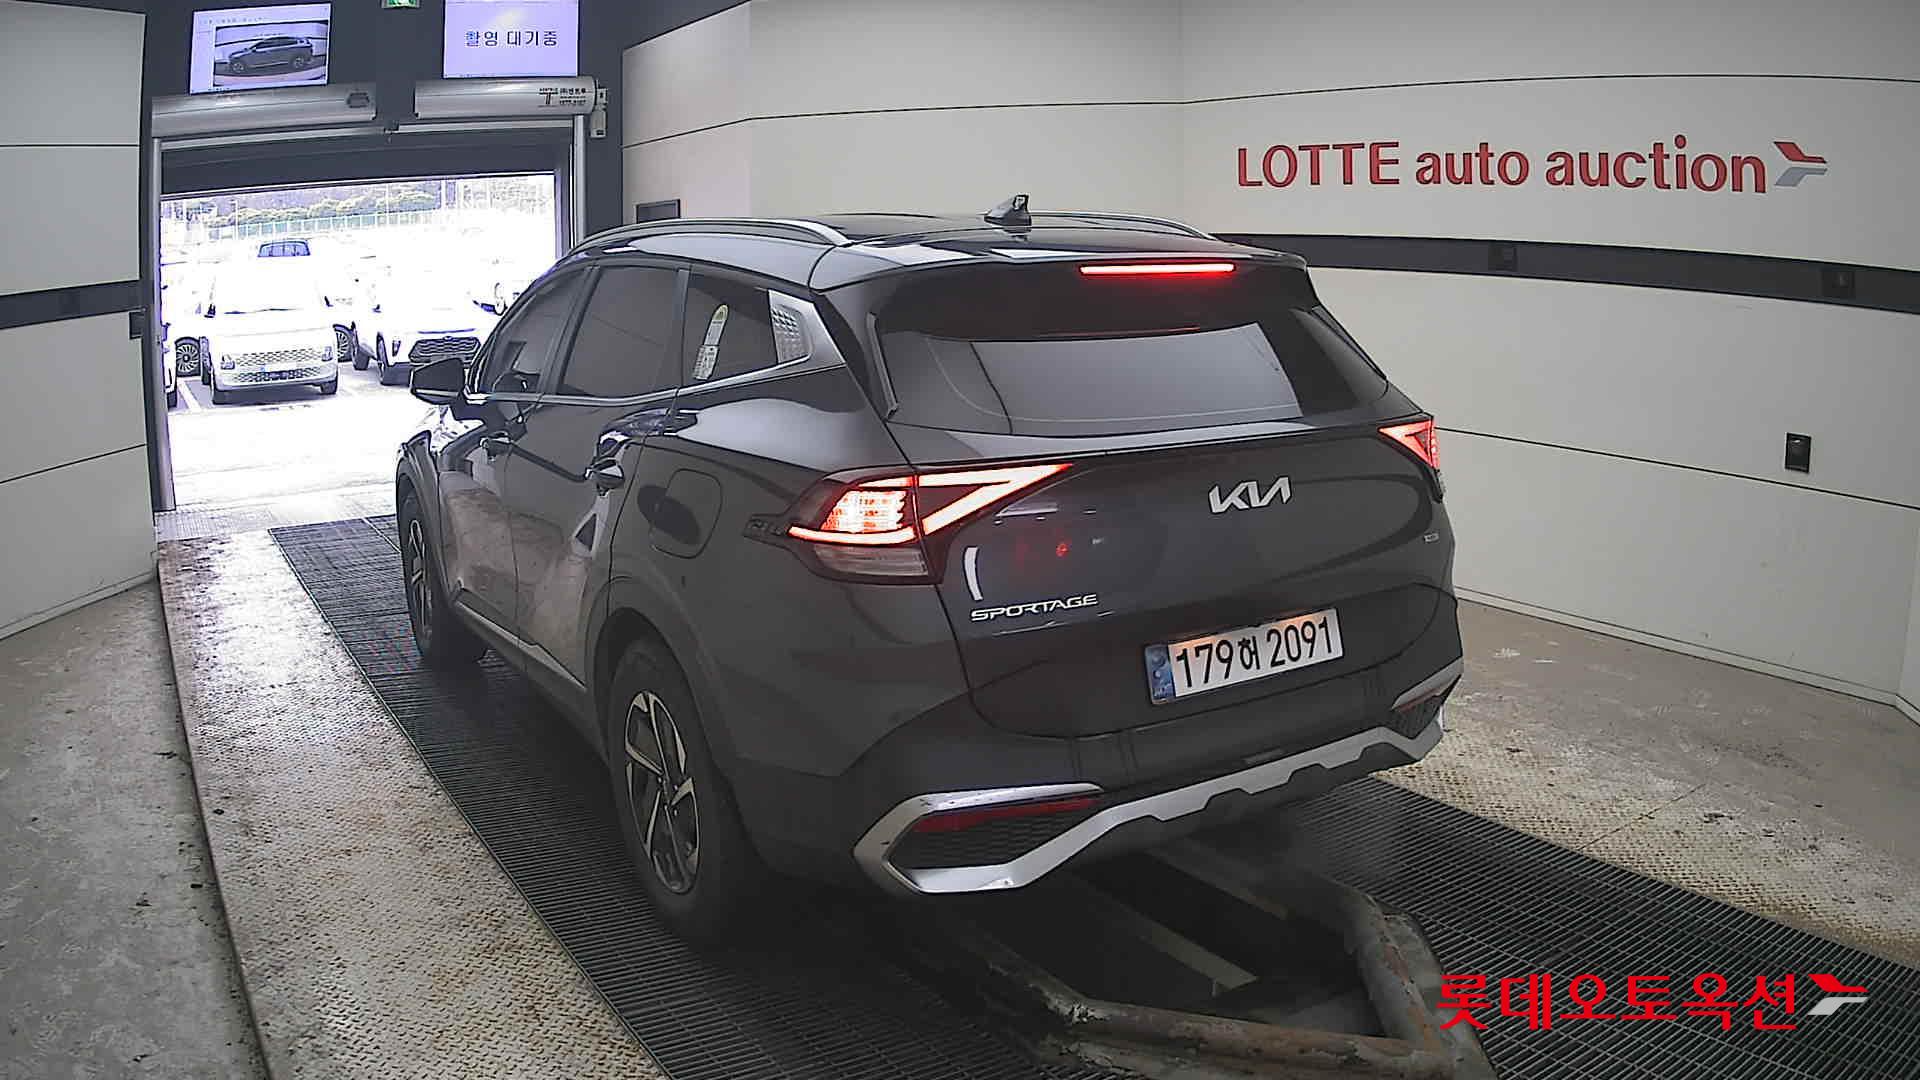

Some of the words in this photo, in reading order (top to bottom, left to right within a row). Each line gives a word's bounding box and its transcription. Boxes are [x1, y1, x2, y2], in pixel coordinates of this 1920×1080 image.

[507, 31, 557, 46] 대기중
[1238, 142, 1400, 187] LOTTE
[1416, 143, 1530, 186] auto
[1546, 135, 1766, 194] auction
[1208, 476, 1291, 513] KIA
[971, 593, 1098, 621] SPORTAGE
